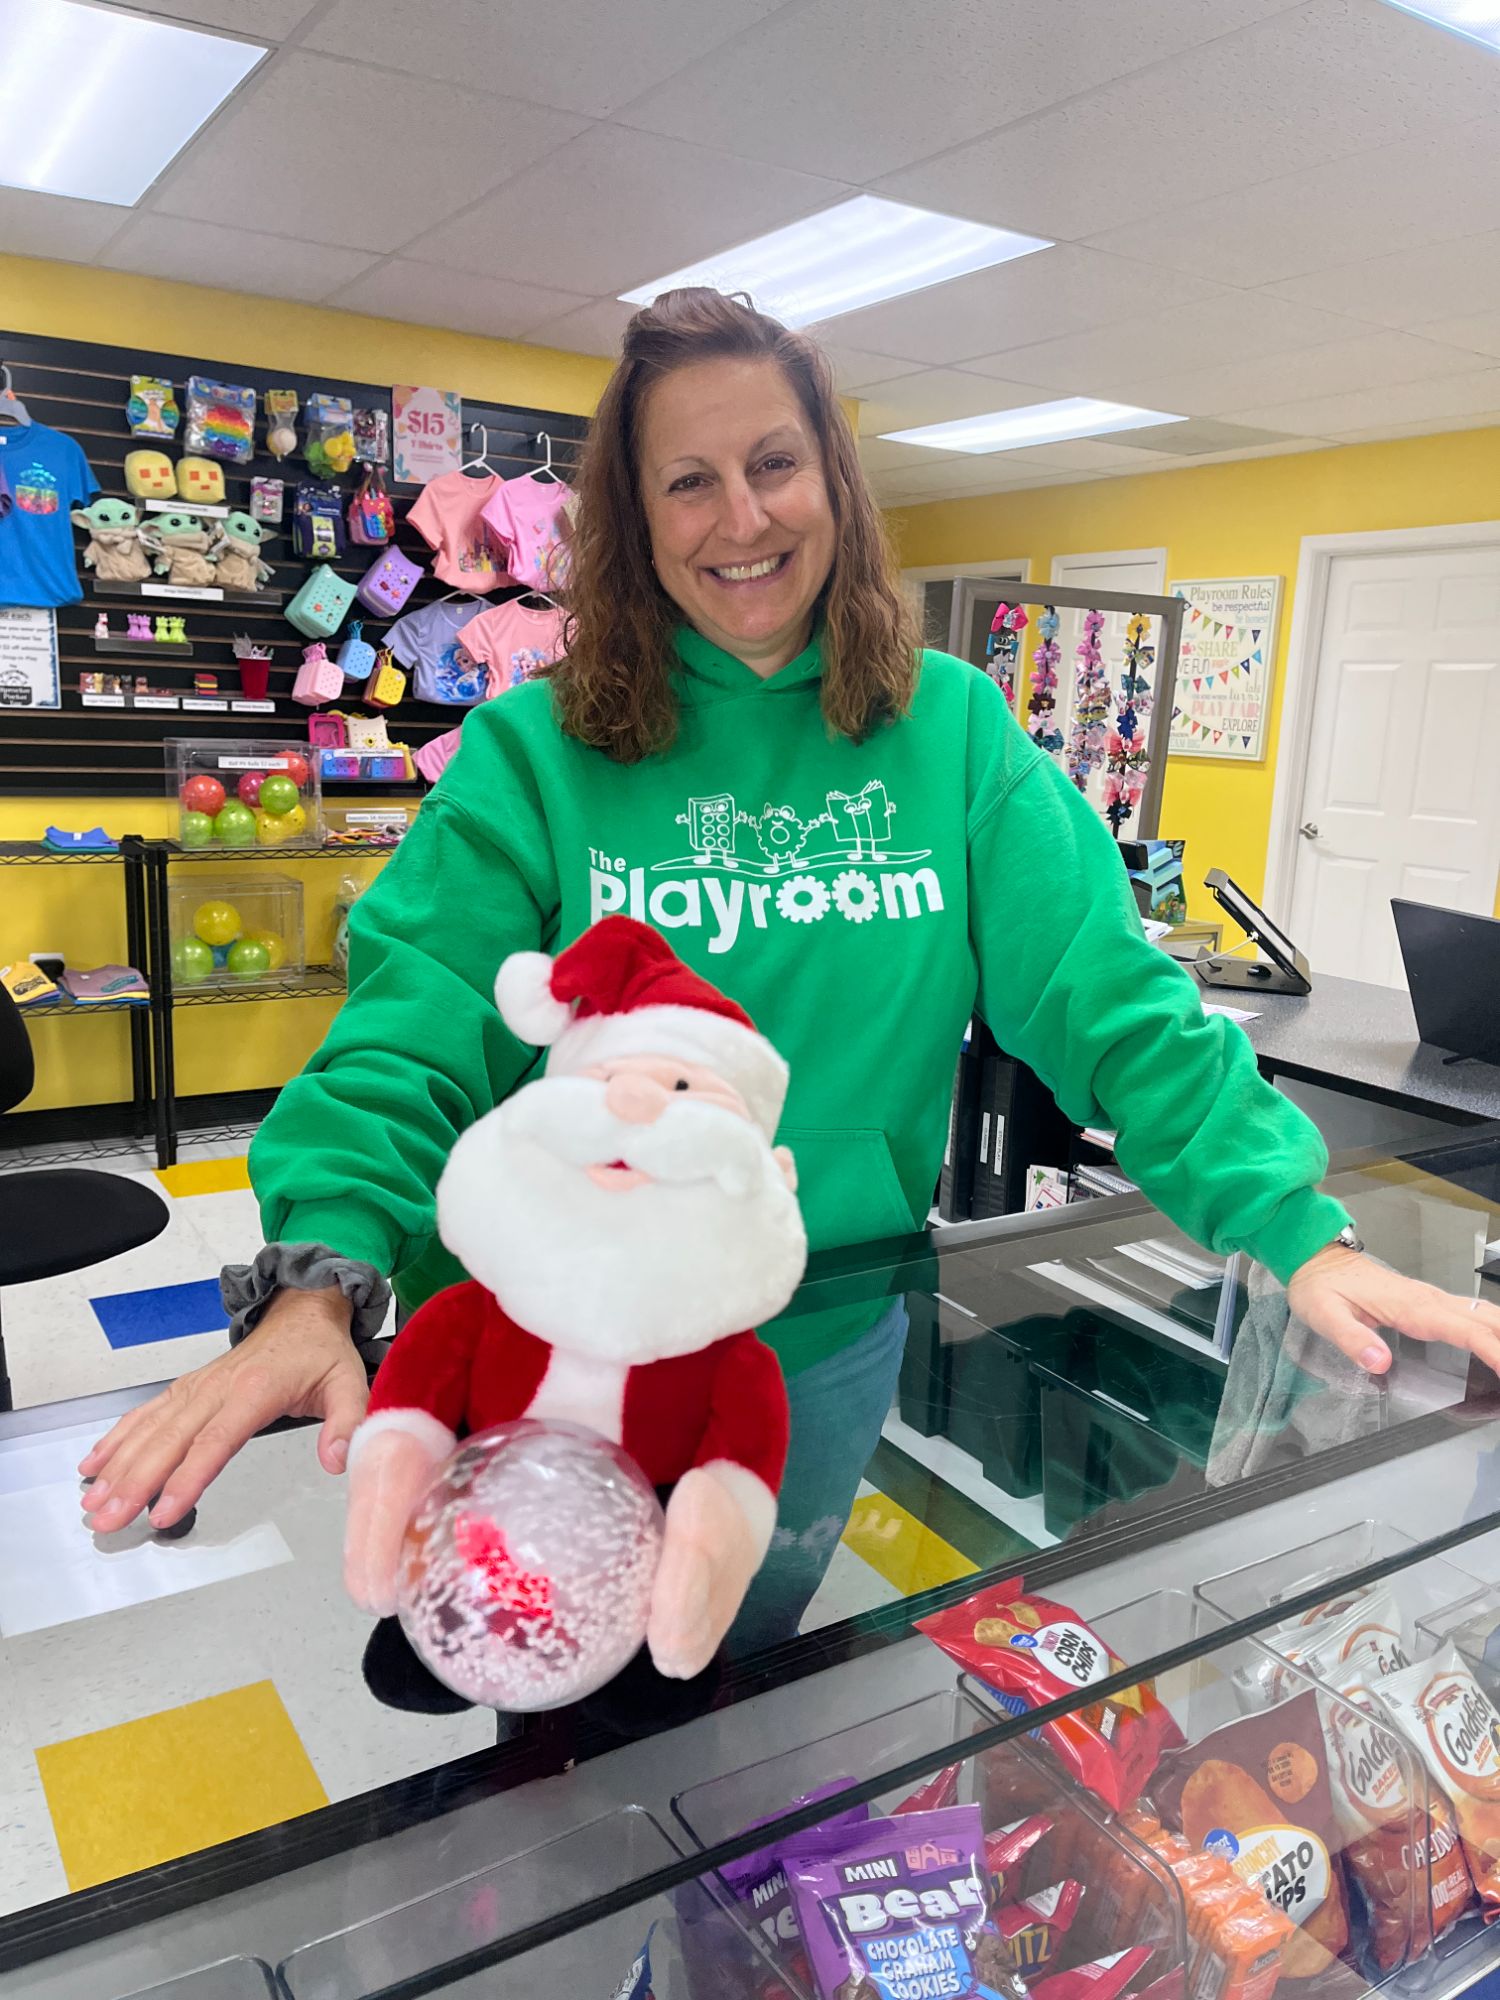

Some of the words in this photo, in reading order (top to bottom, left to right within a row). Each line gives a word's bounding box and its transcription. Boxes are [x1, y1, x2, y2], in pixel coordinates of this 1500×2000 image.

[407, 409, 445, 436] $15
[1190, 586, 1238, 604] Playroom
[1241, 584, 1272, 600] Rules
[1212, 602, 1223, 612] be
[1224, 600, 1270, 613] respectful
[1197, 641, 1238, 658] SHARE
[1191, 658, 1210, 675] FUN
[1221, 718, 1258, 732] EXPLORE
[588, 846, 627, 872] The
[589, 866, 945, 954] Playroom
[1053, 1628, 1082, 1667] CORN
[1071, 1640, 1098, 1682] CHIPS
[1443, 1686, 1492, 1767] Goldfish
[844, 1859, 898, 1883] MINI
[839, 1876, 983, 1933] Bear
[866, 1928, 959, 1960] CHOCOLATE
[1007, 1924, 1052, 1968] ITZ
[880, 1951, 955, 1980] GRAHAM
[889, 1974, 961, 2000] COOKIES
